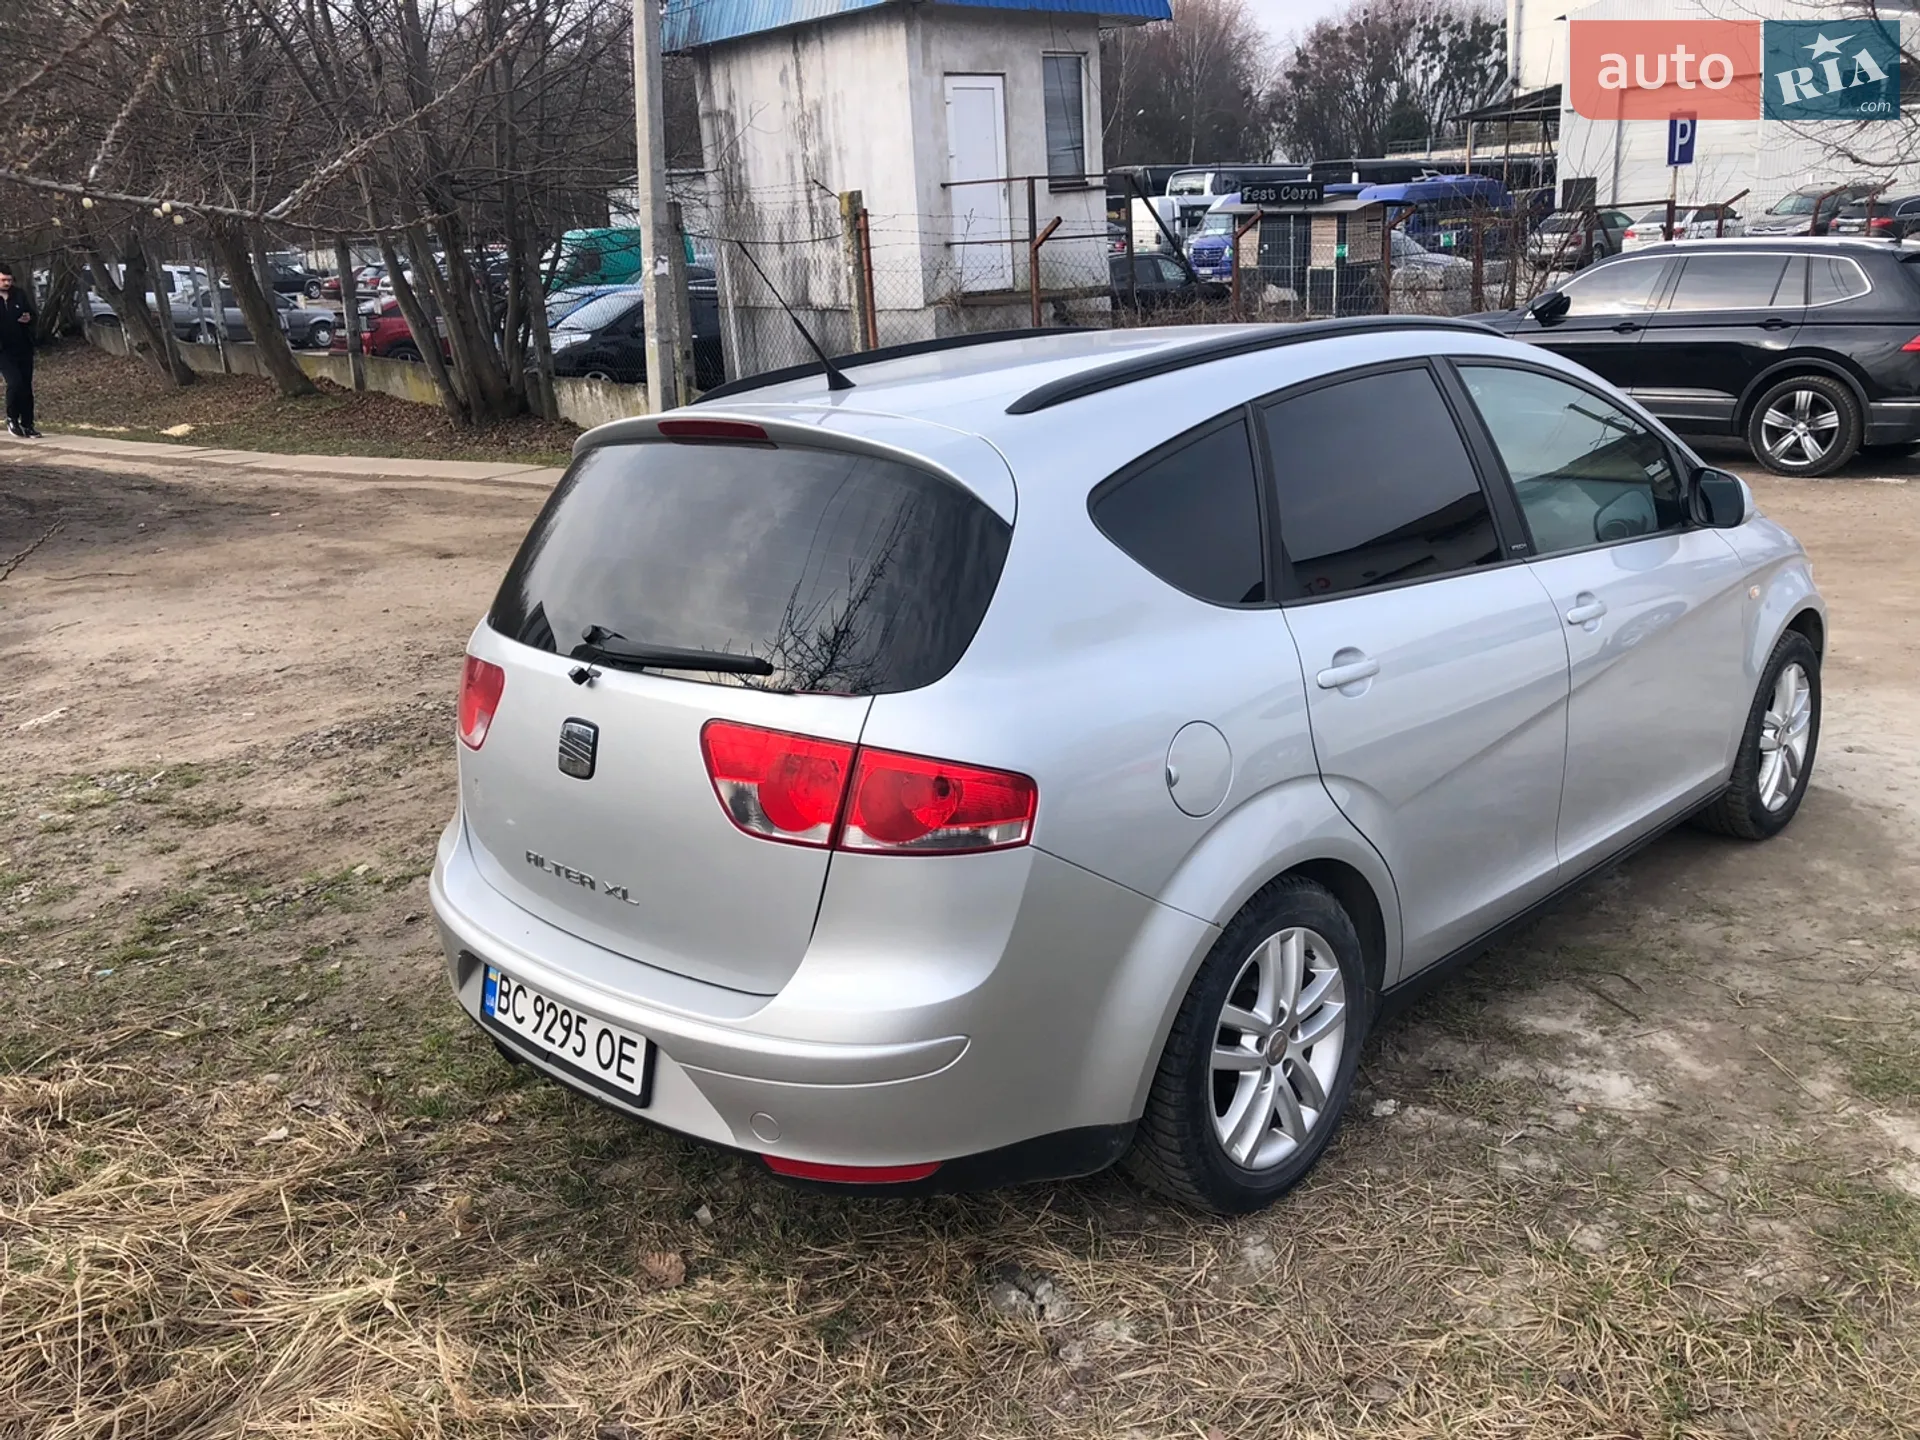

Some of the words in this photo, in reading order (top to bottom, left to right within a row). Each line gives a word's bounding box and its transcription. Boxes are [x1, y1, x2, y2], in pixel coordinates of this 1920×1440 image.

[1674, 117, 1692, 162] P
[1242, 186, 1276, 201] Fest
[1280, 185, 1318, 201] Corn
[525, 849, 596, 891] ALTEA
[603, 880, 640, 906] XL
[497, 973, 527, 1025] BC
[531, 994, 588, 1058] 9295
[596, 1027, 638, 1084] OE
